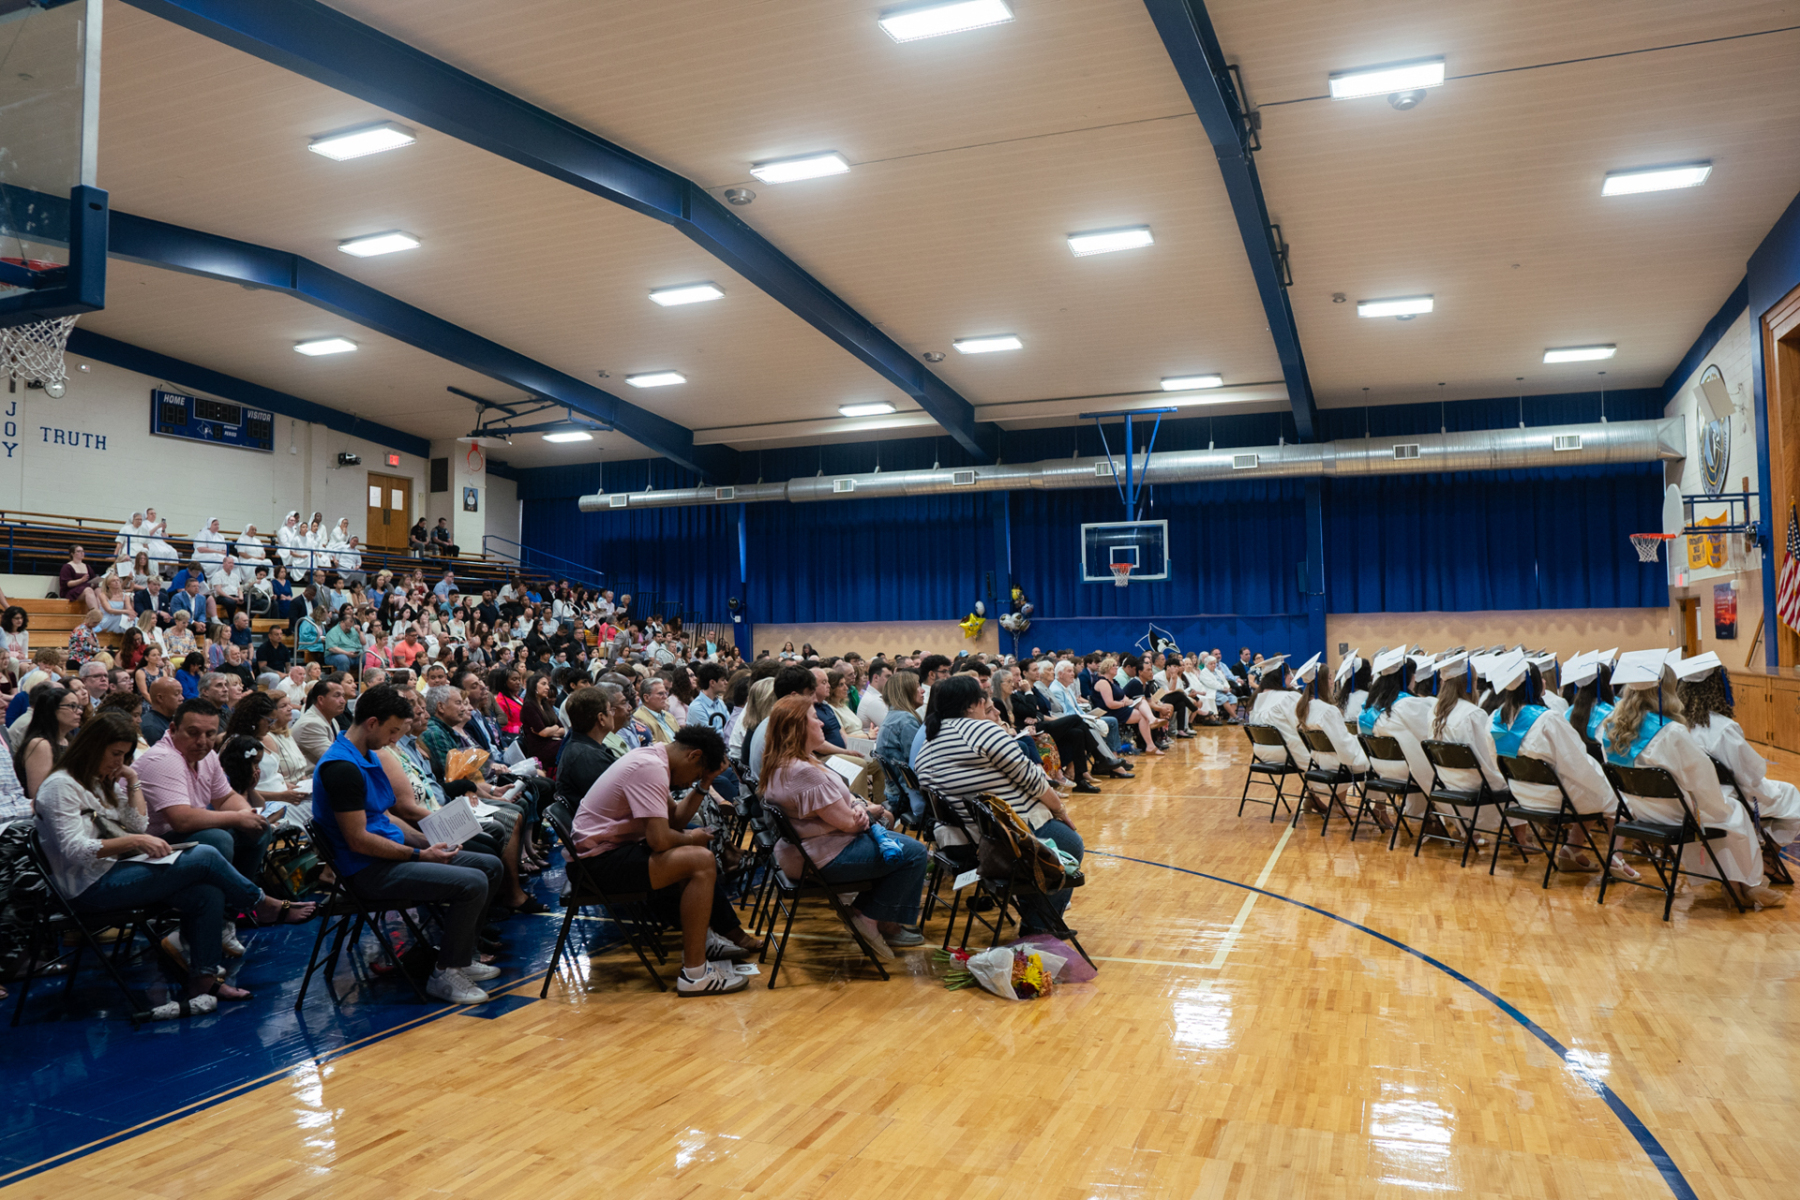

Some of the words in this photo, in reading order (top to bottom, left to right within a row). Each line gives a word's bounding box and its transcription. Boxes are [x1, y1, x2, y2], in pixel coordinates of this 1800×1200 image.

[163, 393, 186, 406] HOME
[247, 409, 272, 422] VISITOR
[1, 401, 19, 458] JOY
[39, 426, 107, 451] TRUTH
